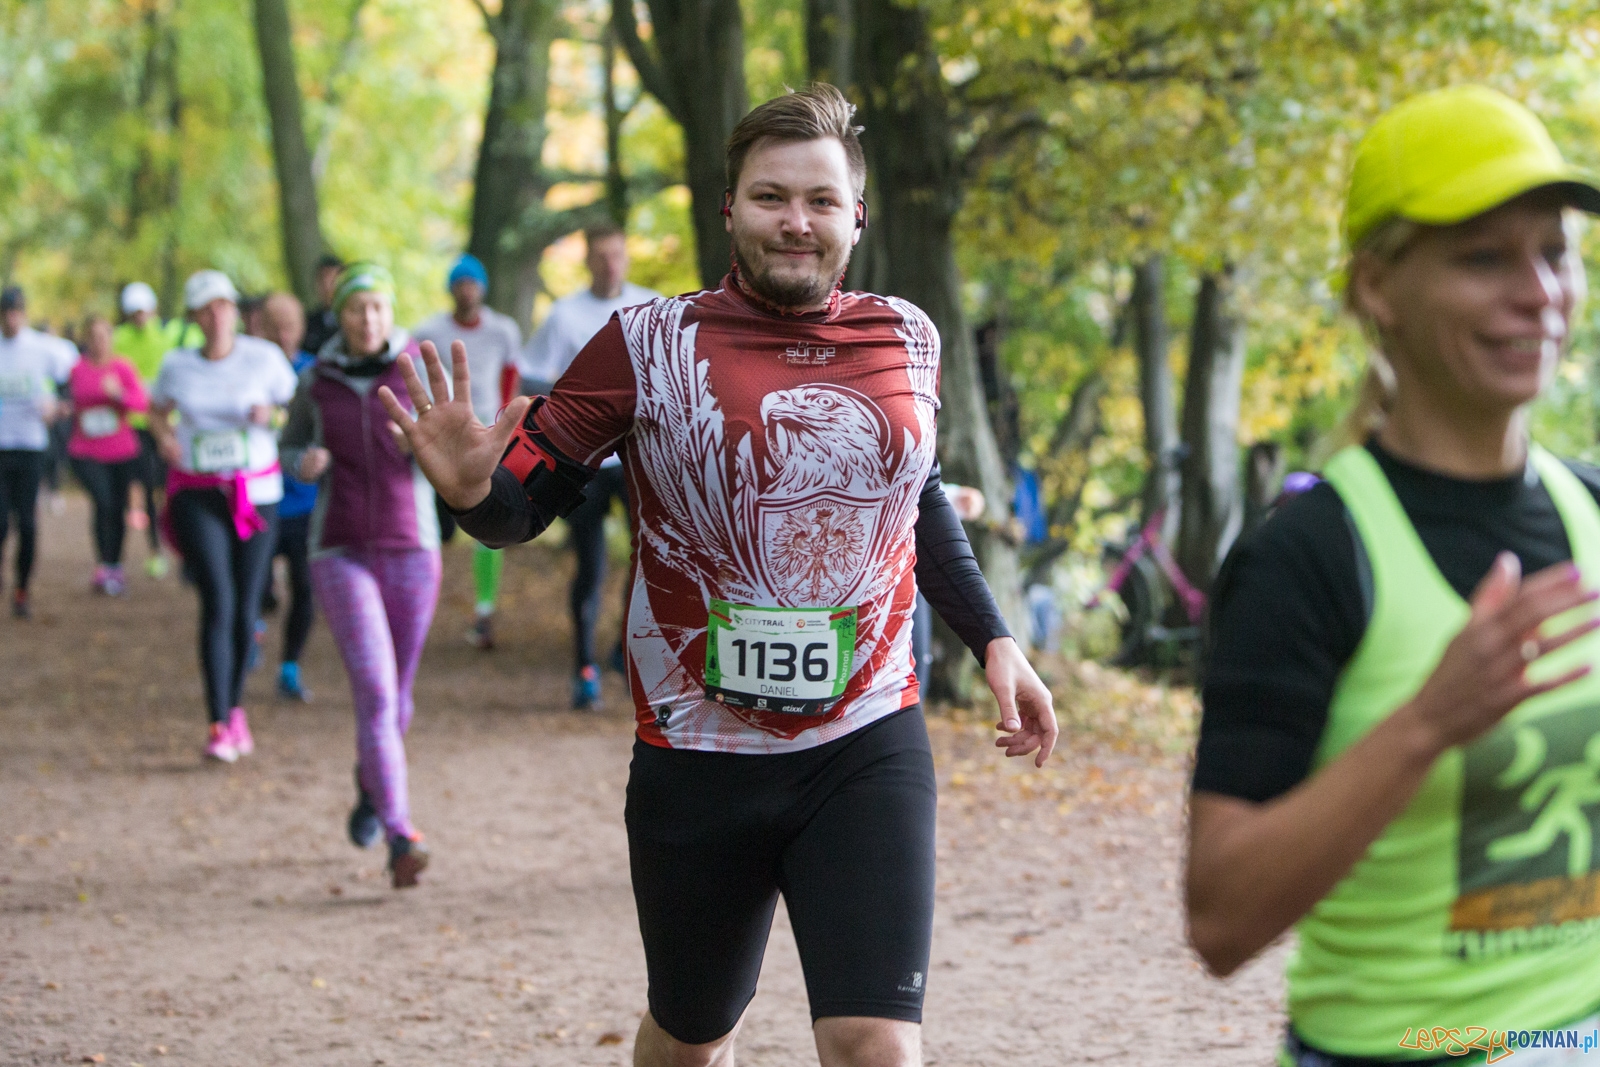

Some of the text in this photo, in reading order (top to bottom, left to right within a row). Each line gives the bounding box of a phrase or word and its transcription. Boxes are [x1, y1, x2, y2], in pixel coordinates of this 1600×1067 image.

[726, 585, 755, 600] SURGE
[732, 638, 828, 682] 1136
[839, 650, 850, 684] Poznań
[760, 684, 799, 697] DANIEL
